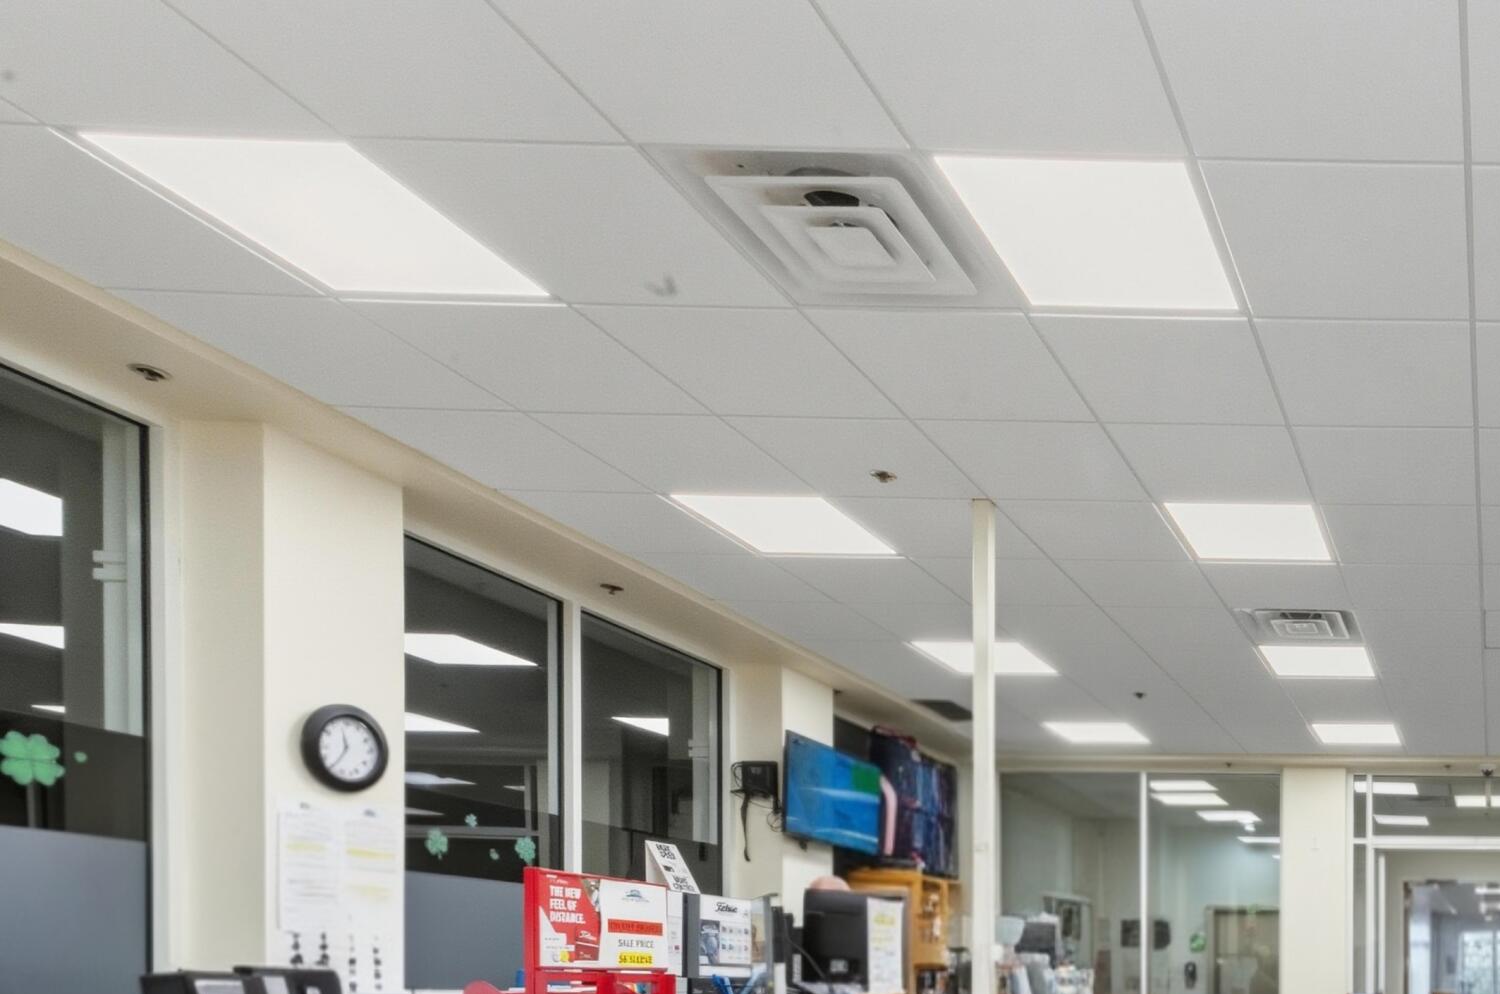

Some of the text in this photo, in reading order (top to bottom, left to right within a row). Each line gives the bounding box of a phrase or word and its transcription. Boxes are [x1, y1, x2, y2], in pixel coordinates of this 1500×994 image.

[549, 885, 582, 900] THE NEW
[549, 898, 577, 911] FEEL OF
[617, 939, 656, 949] SALE PRICE
